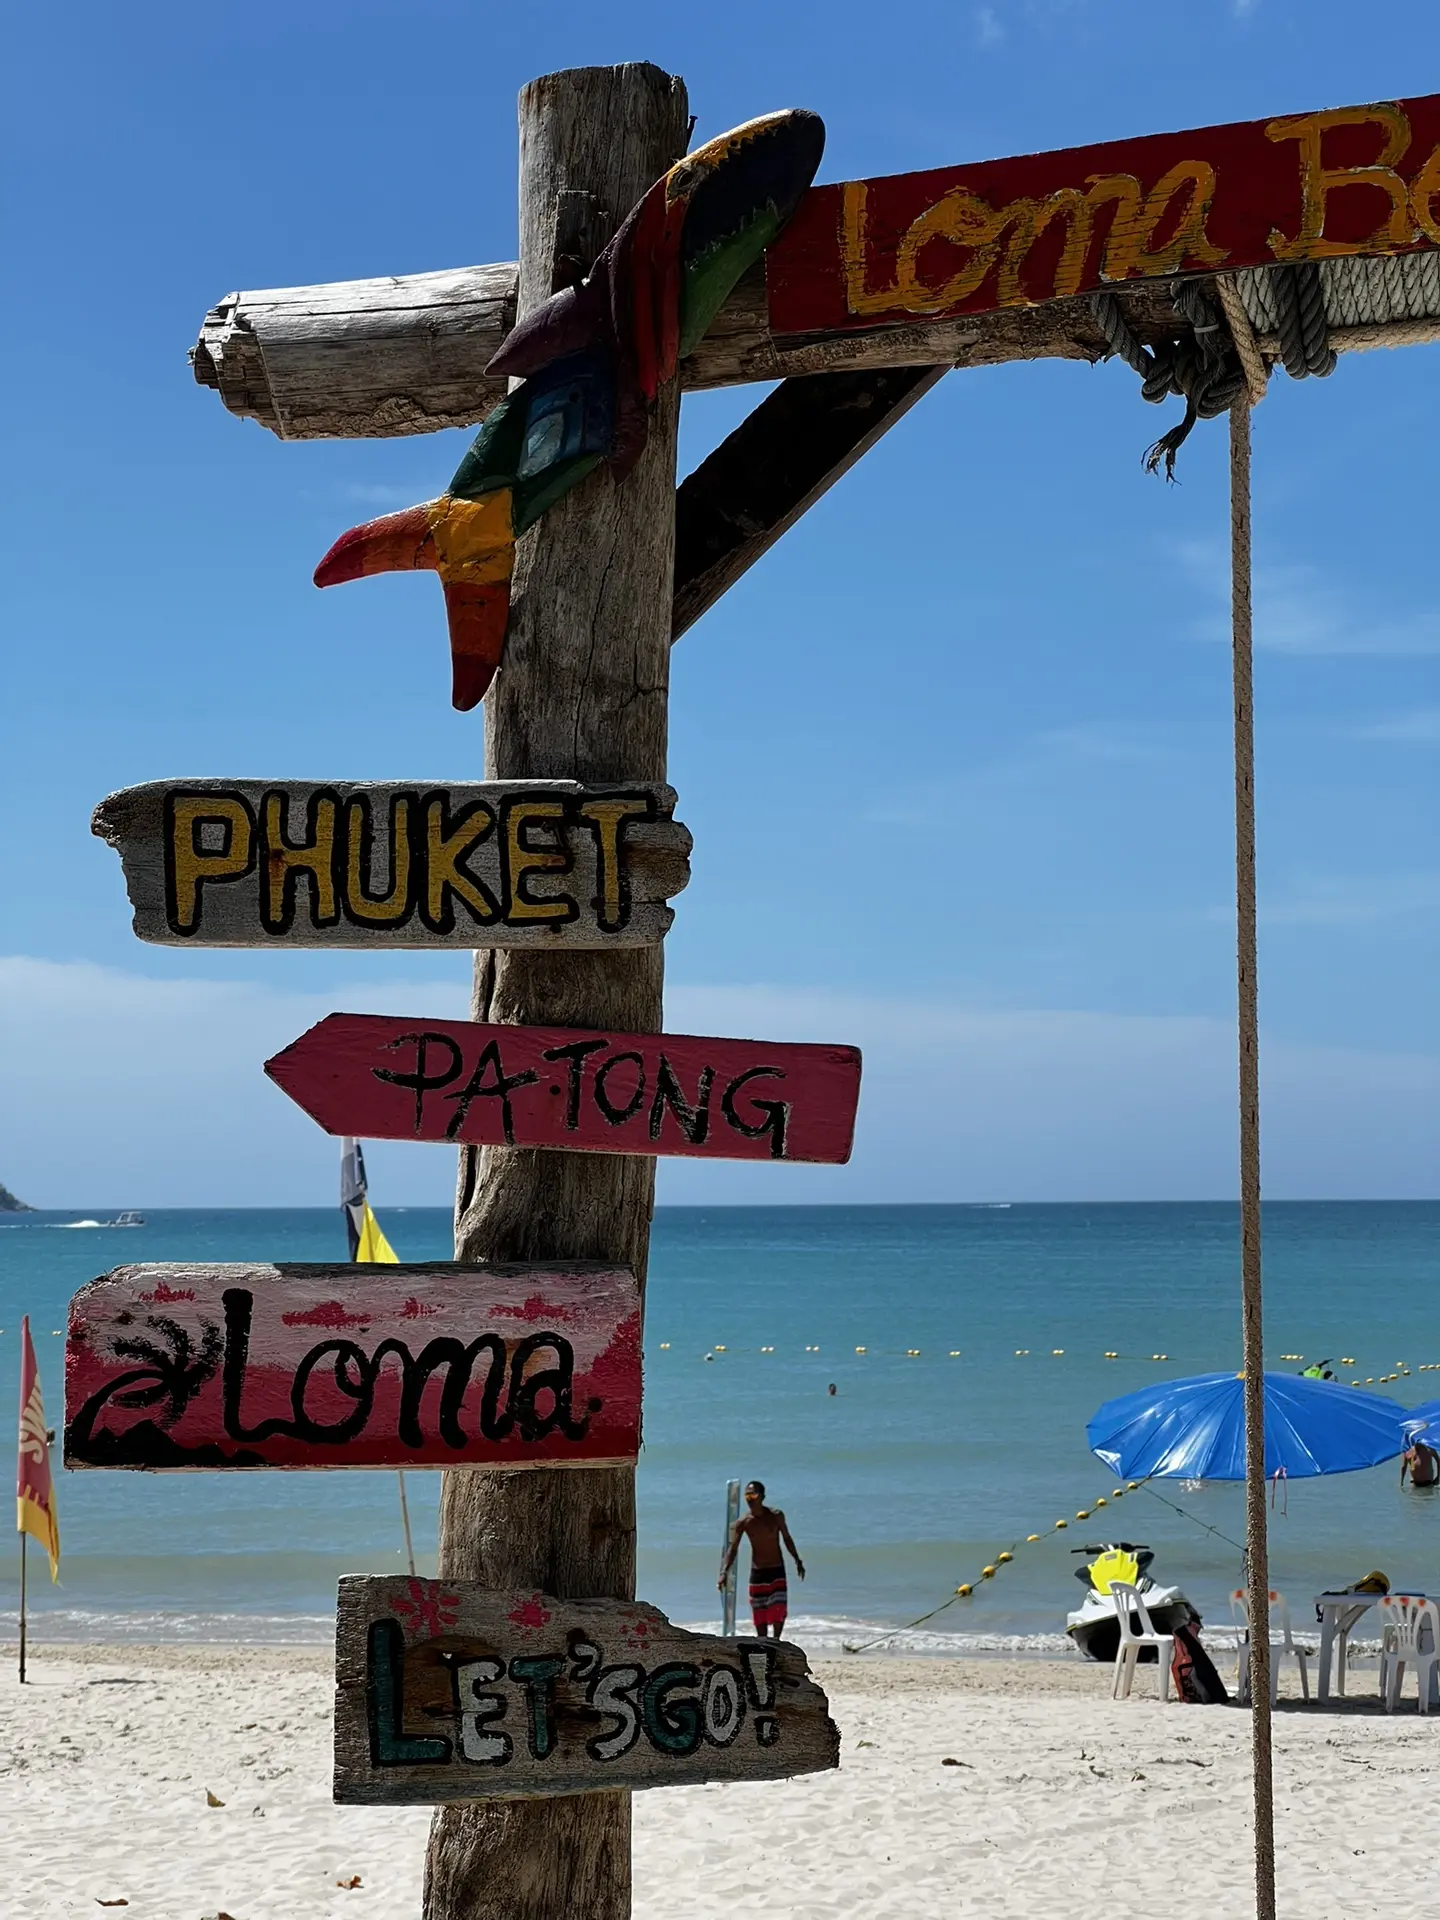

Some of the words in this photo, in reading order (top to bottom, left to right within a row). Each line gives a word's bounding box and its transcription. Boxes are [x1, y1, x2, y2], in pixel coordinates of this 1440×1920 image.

[840, 160, 1231, 315] Loma
[163, 788, 657, 937] PHUKET
[222, 1288, 590, 1449] Loma
